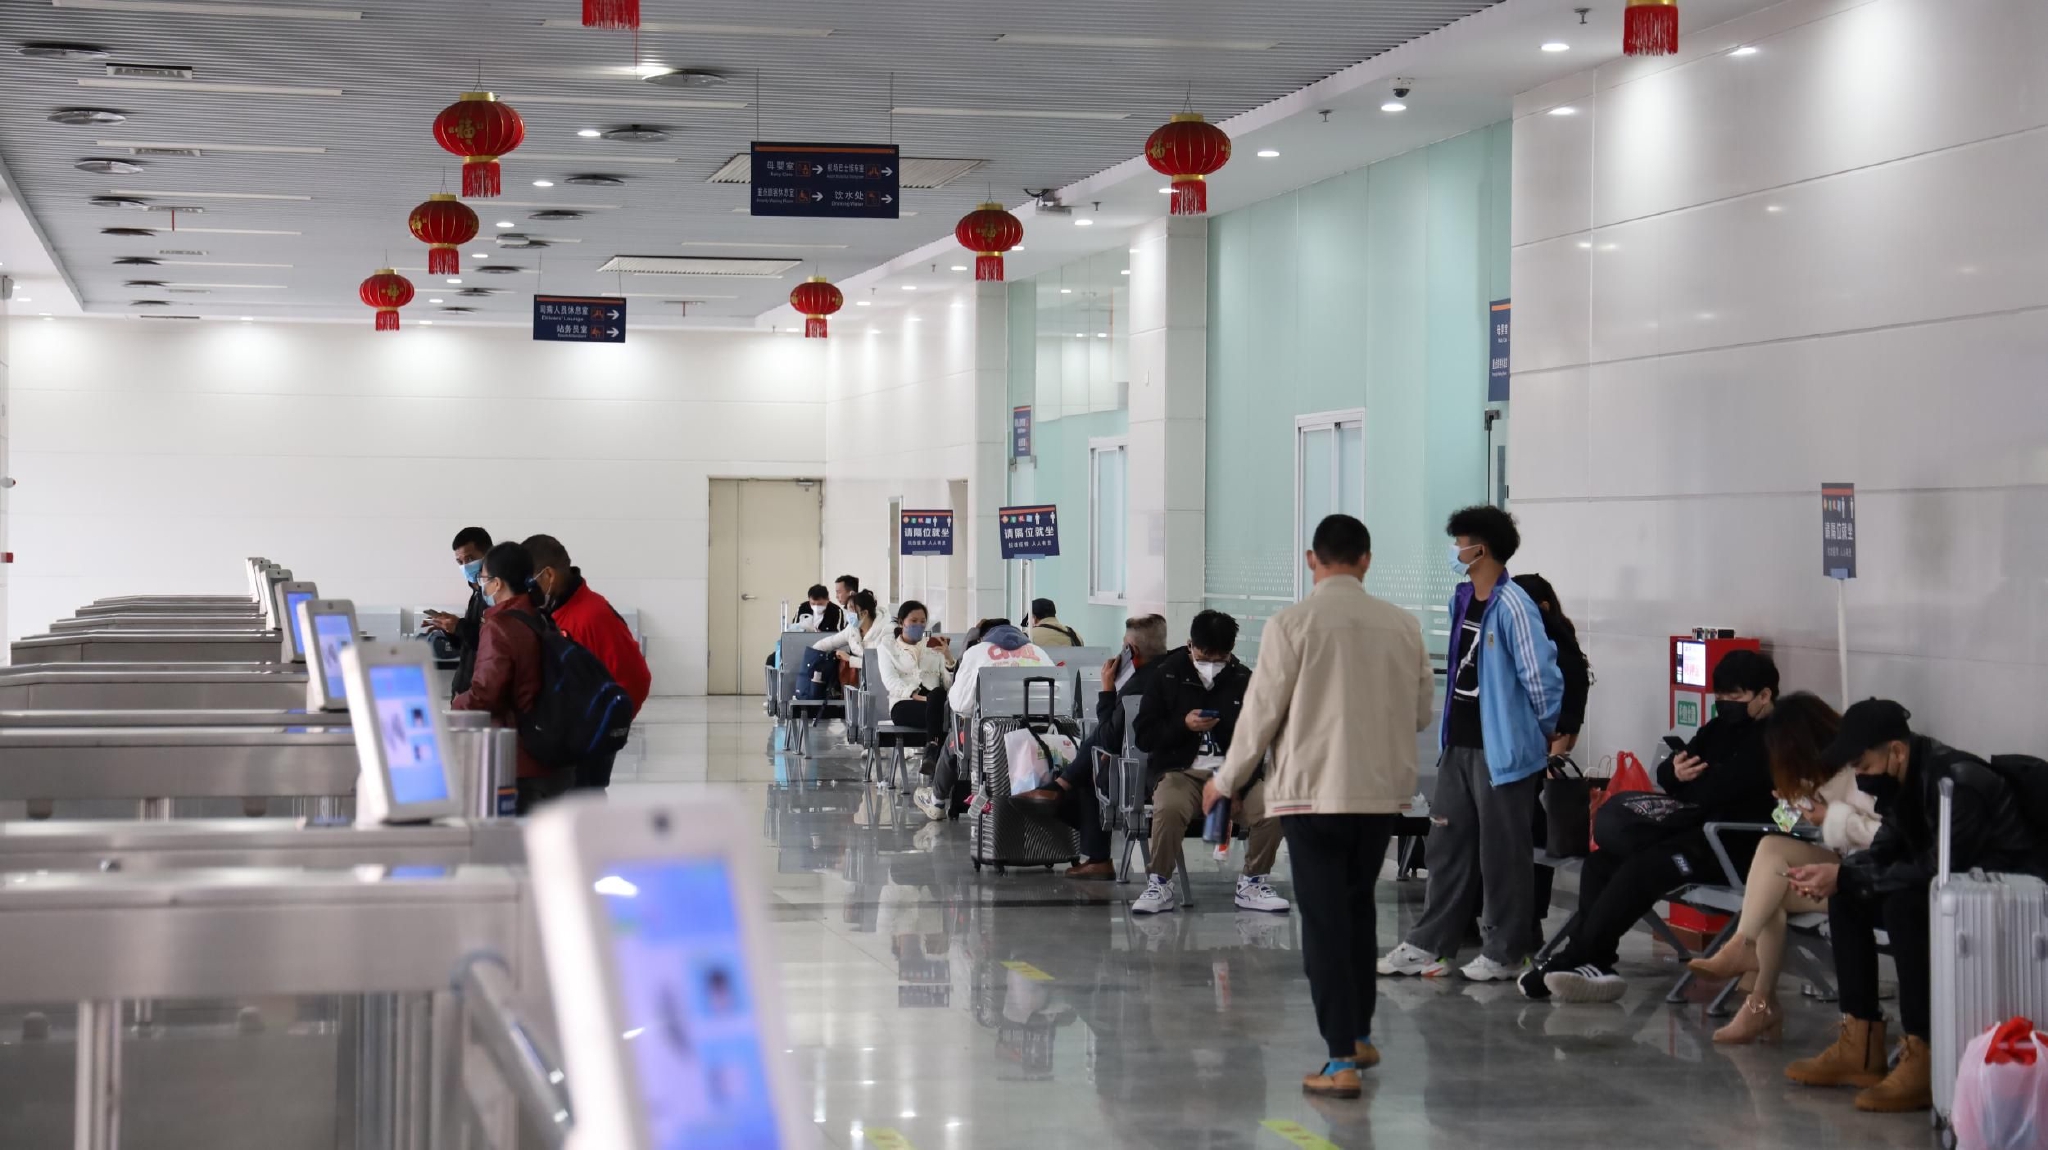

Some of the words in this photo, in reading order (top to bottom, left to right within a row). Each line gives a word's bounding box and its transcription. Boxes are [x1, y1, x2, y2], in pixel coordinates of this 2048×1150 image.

[766, 160, 795, 171] 母婴室
[834, 190, 864, 201] 饮水处
[904, 527, 950, 538] 请隔位就坐
[1004, 526, 1055, 539] 请隔位就坐
